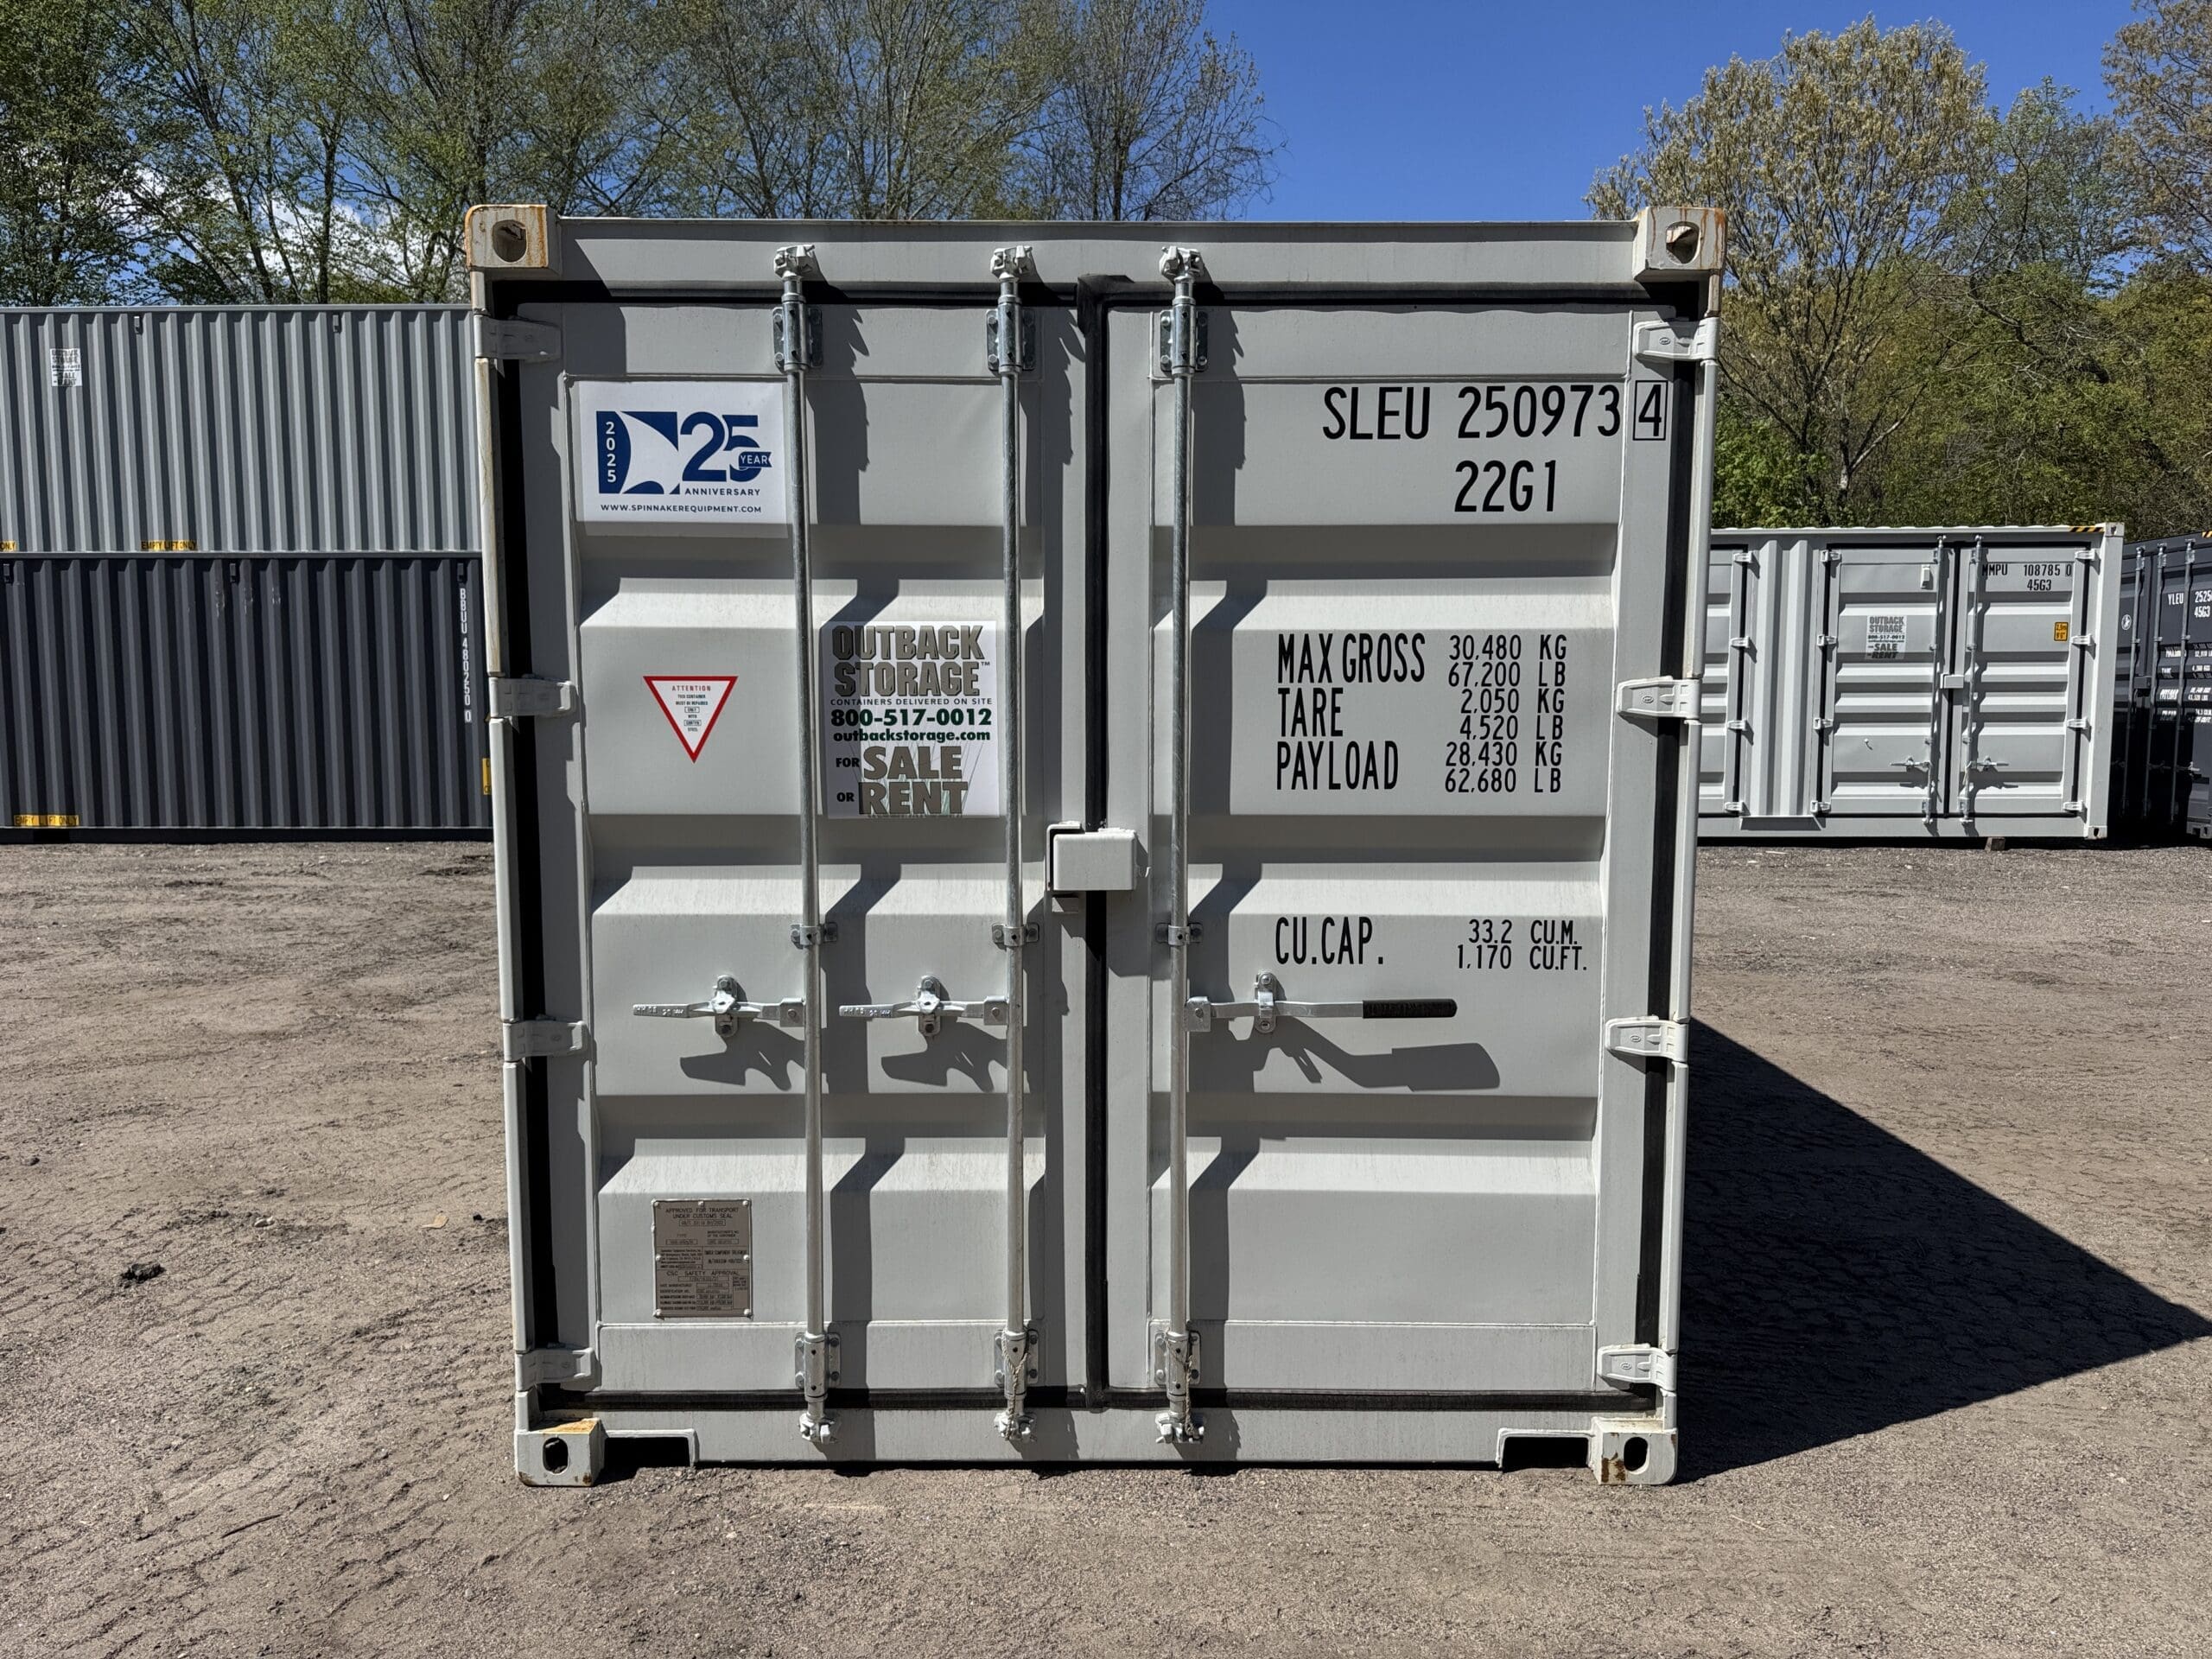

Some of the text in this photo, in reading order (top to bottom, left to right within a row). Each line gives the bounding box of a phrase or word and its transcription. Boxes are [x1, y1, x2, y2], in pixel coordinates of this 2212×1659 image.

[1322, 384, 1662, 440] SLEU 250973 4
[605, 421, 617, 484] 2025
[740, 454, 768, 465] YEAR
[1454, 460, 1557, 512] 22G1
[601, 504, 762, 514] WWW.SPINNAKEREQUIPMENT.COM
[1982, 563, 2008, 576] MMPU
[2024, 564, 2061, 576] 108785
[2027, 579, 2052, 591] 45G3
[2168, 593, 2184, 605] YLEU
[2194, 606, 2210, 618] 45G3
[832, 625, 985, 660] OUTBACK
[1874, 643, 1897, 652] SALE
[1278, 632, 1567, 683] MAX GROSS 30,480 KG
[462, 637, 471, 706] 480250
[834, 661, 981, 697] STORAGE
[1448, 662, 1566, 688] 67,200 LB
[830, 709, 992, 727] 800-517-0012
[1278, 687, 1565, 737] TARE 2,050 KG
[833, 728, 991, 743] outbackstorage.com
[1459, 715, 1563, 741] 4,520 LB
[836, 746, 963, 780] FOR SALE
[1276, 741, 1561, 790] PAYLOAD 28,430 KG
[1445, 768, 1561, 793] 62,680 LB
[836, 781, 969, 815] OR RENT
[1275, 917, 1578, 965] CU.CAP. 33.2 CU.M.
[1458, 944, 1587, 970] 1,170 CU.FT.
